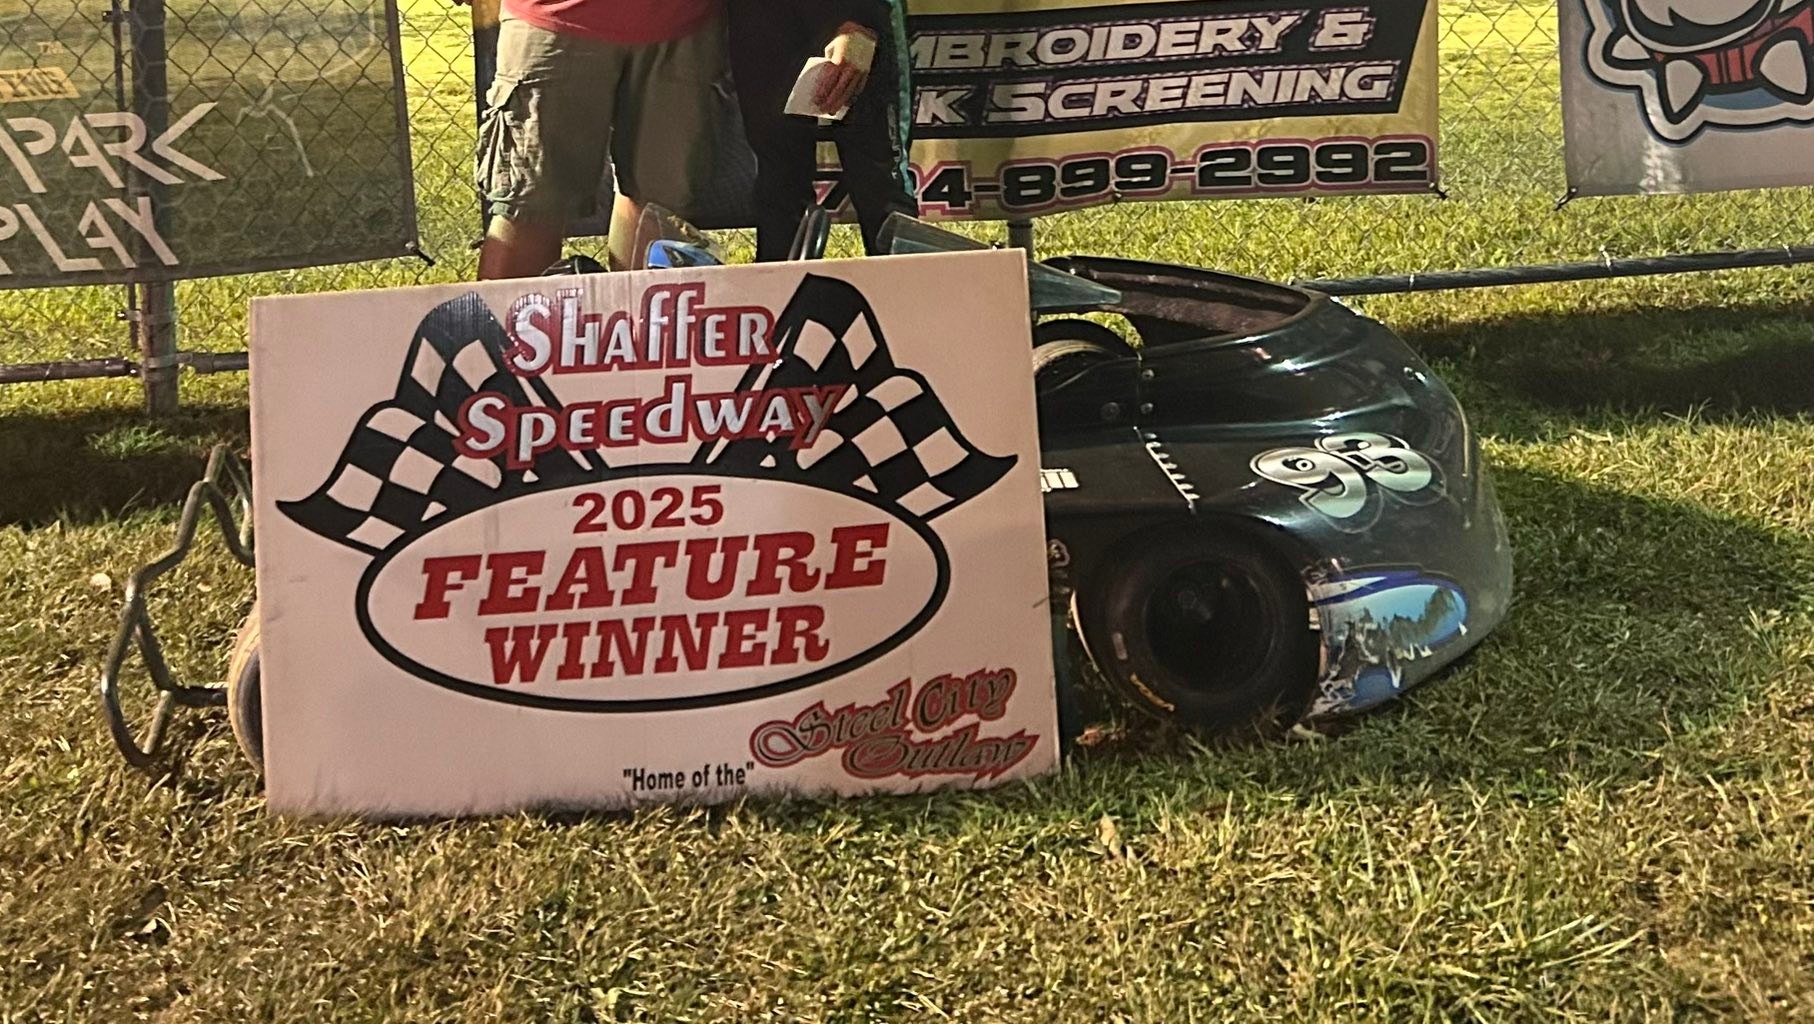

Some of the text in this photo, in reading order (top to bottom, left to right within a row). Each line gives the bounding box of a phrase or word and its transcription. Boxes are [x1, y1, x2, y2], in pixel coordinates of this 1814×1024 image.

[1314, 10, 1371, 49] &
[988, 64, 1393, 123] SCREENING
[0, 102, 227, 193] PARK
[813, 142, 1429, 212] 74-899-2992
[573, 485, 724, 534] 2025
[414, 523, 890, 621] FEATURE
[484, 604, 829, 684] WINNER
[751, 668, 1015, 765] Steel City
[623, 762, 755, 792] "Home of the"
[845, 724, 1037, 778] Outlaw
